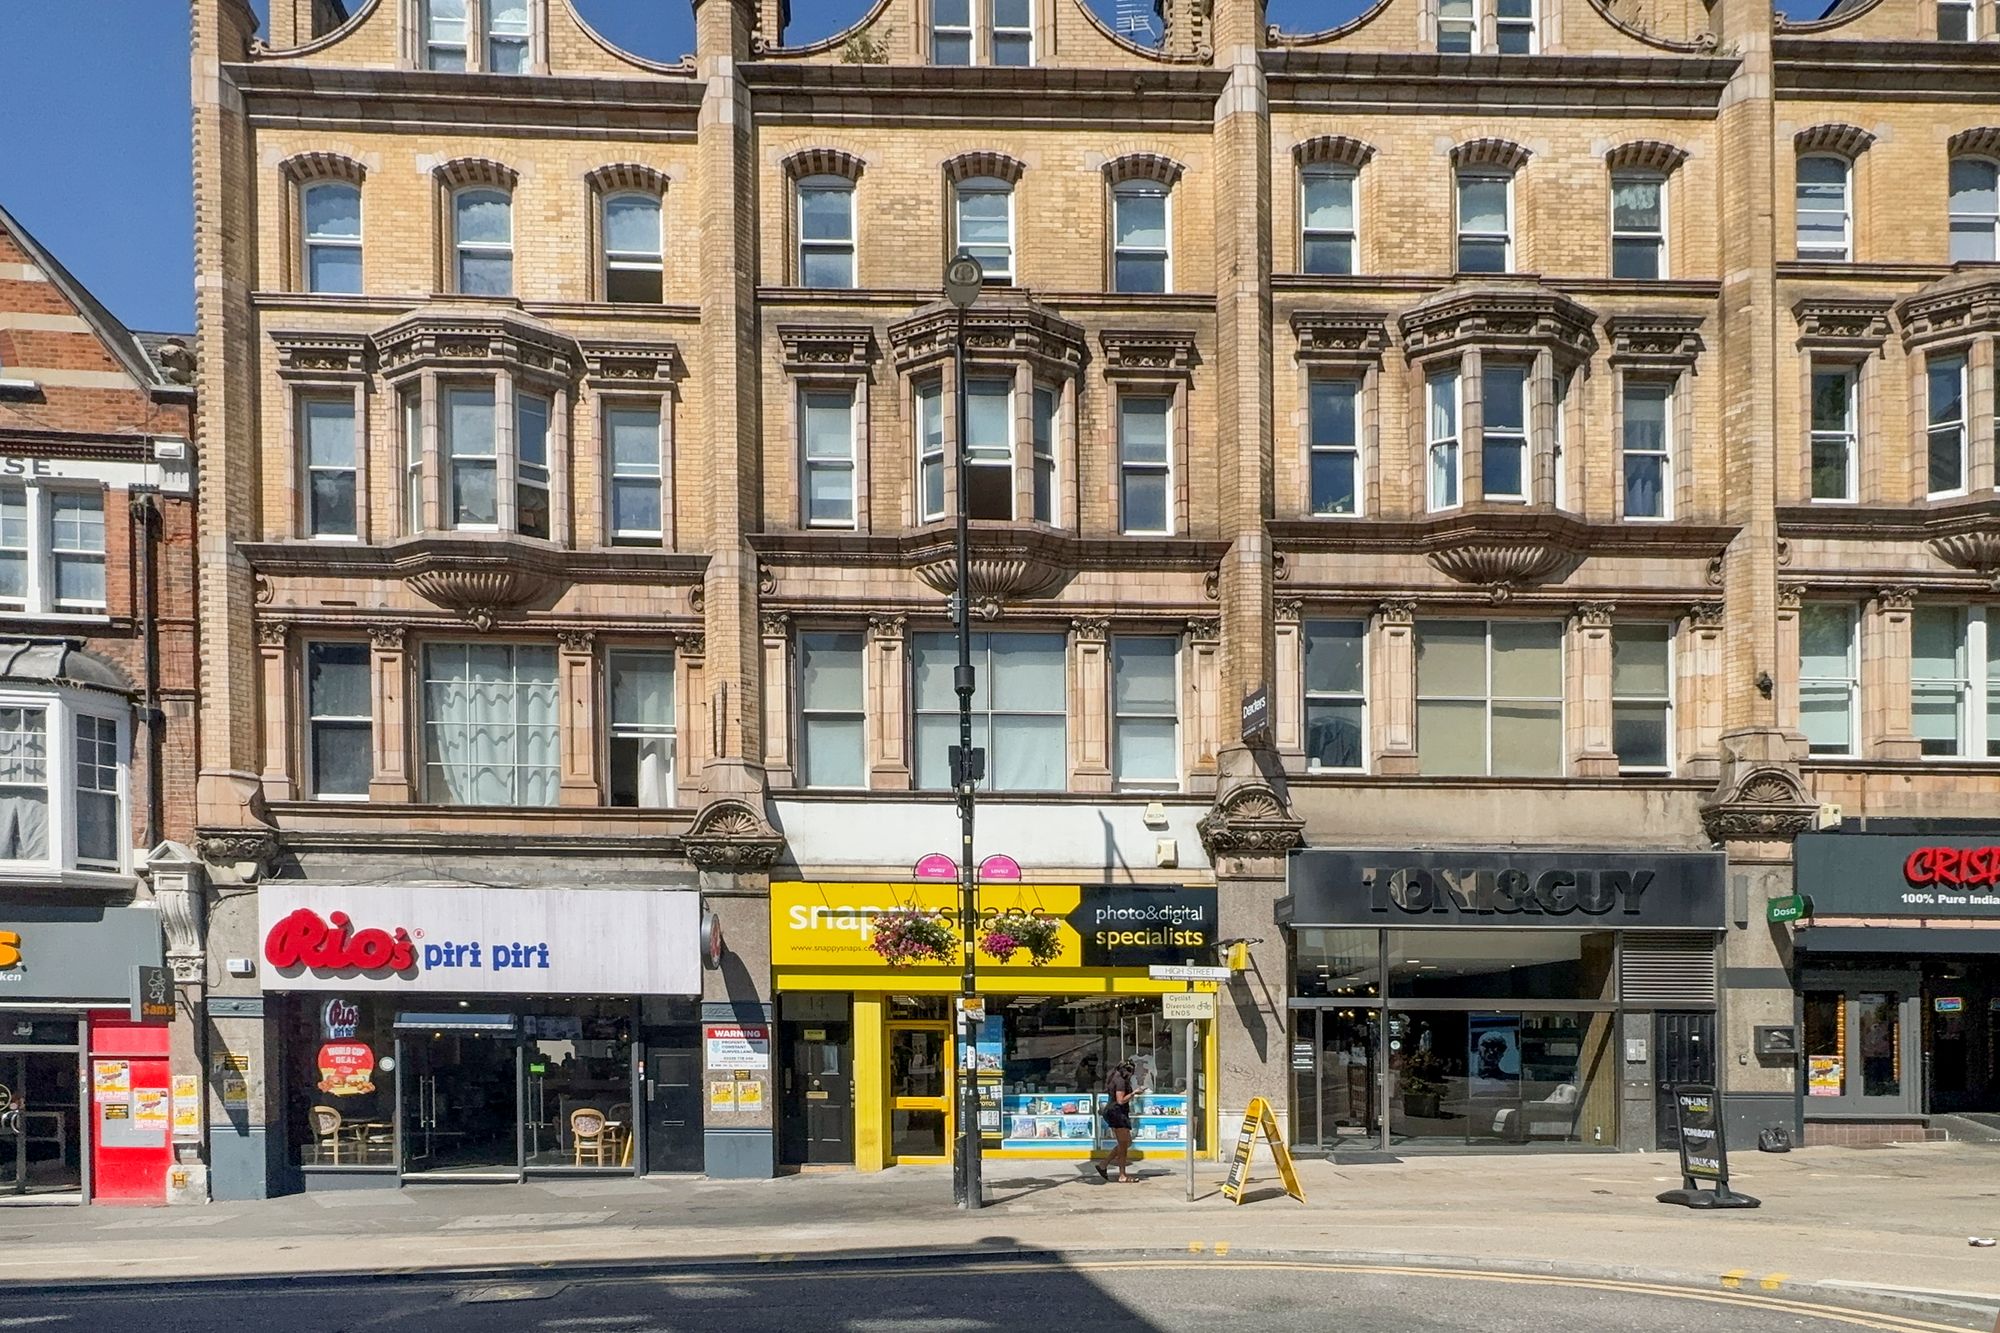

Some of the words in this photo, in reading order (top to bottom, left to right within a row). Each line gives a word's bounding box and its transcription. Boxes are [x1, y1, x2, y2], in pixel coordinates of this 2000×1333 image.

[1362, 868, 1656, 914] TONI&GUY
[1901, 893, 1934, 904] 100%
[1938, 894, 1967, 904] Pure
[1096, 904, 1203, 925] photo&digital
[1774, 907, 1796, 917] Dosa
[265, 908, 416, 972] Rio's
[425, 941, 482, 970] piri
[493, 942, 550, 971] piri
[1096, 926, 1204, 950] specialists
[1165, 967, 1184, 975] HIGH
[1186, 968, 1216, 976] STREET
[142, 1002, 175, 1016] Sam's
[714, 1029, 762, 1038] WARNING
[327, 1047, 351, 1056] WORLD
[1680, 1096, 1708, 1107] ON-LINE
[1683, 1127, 1716, 1138] TONI&GUY
[1688, 1156, 1719, 1169] WALK-IN
